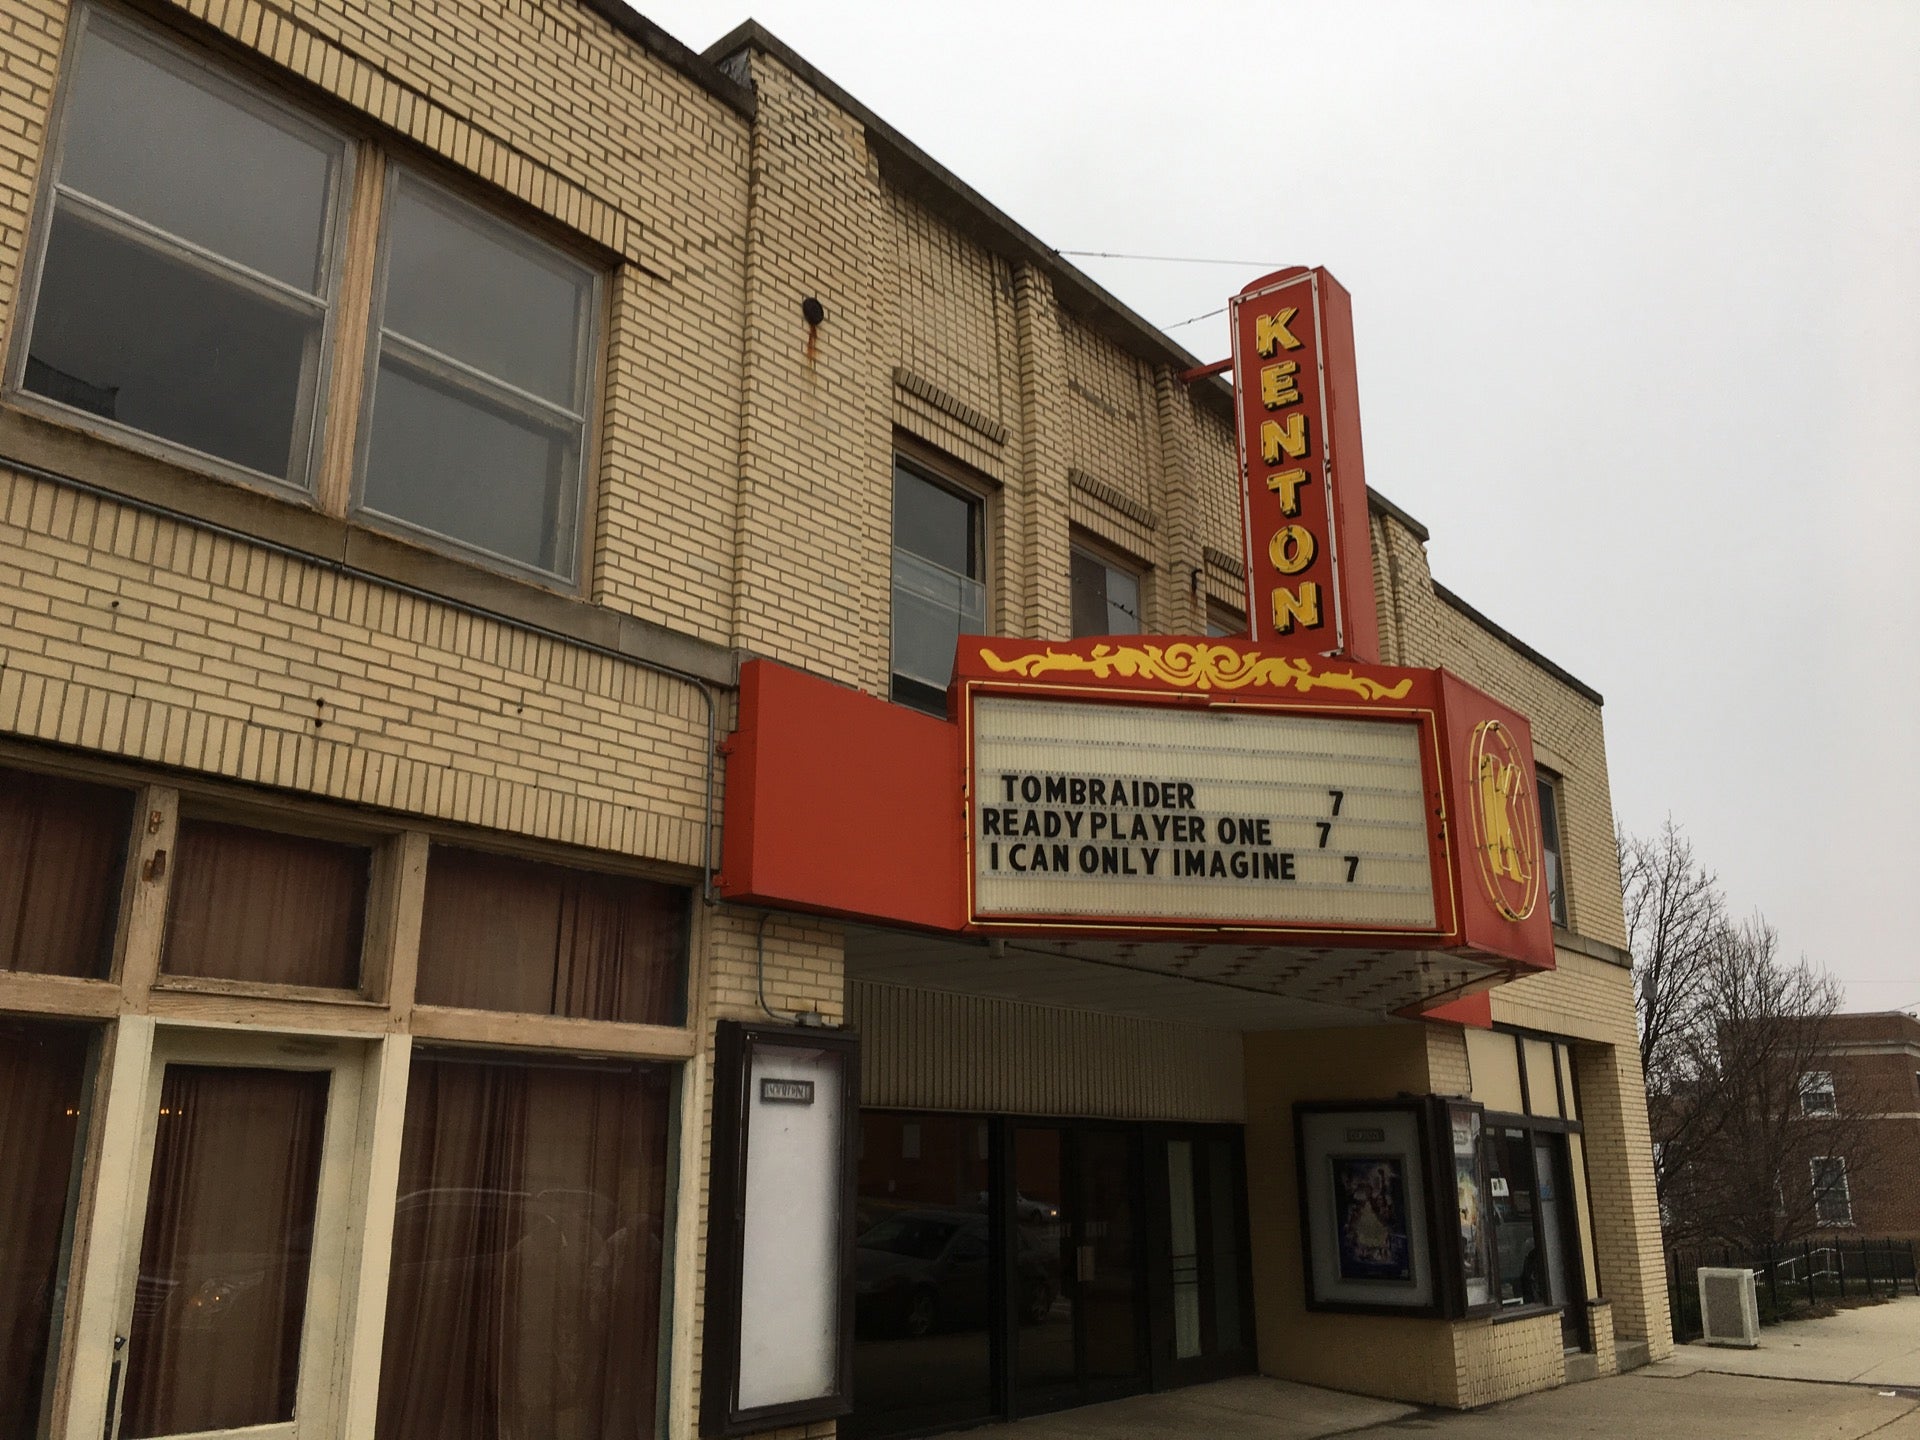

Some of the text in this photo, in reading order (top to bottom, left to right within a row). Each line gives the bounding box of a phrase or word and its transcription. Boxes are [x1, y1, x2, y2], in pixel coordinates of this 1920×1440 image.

[1255, 307, 1320, 634] KENTON
[1000, 774, 1344, 817] TOMBRAIDER 7
[982, 807, 1332, 849] READY PLAYER ONE 7
[1480, 753, 1529, 884] K
[990, 841, 1360, 883] I CAN ONLY IMAGINE 7
